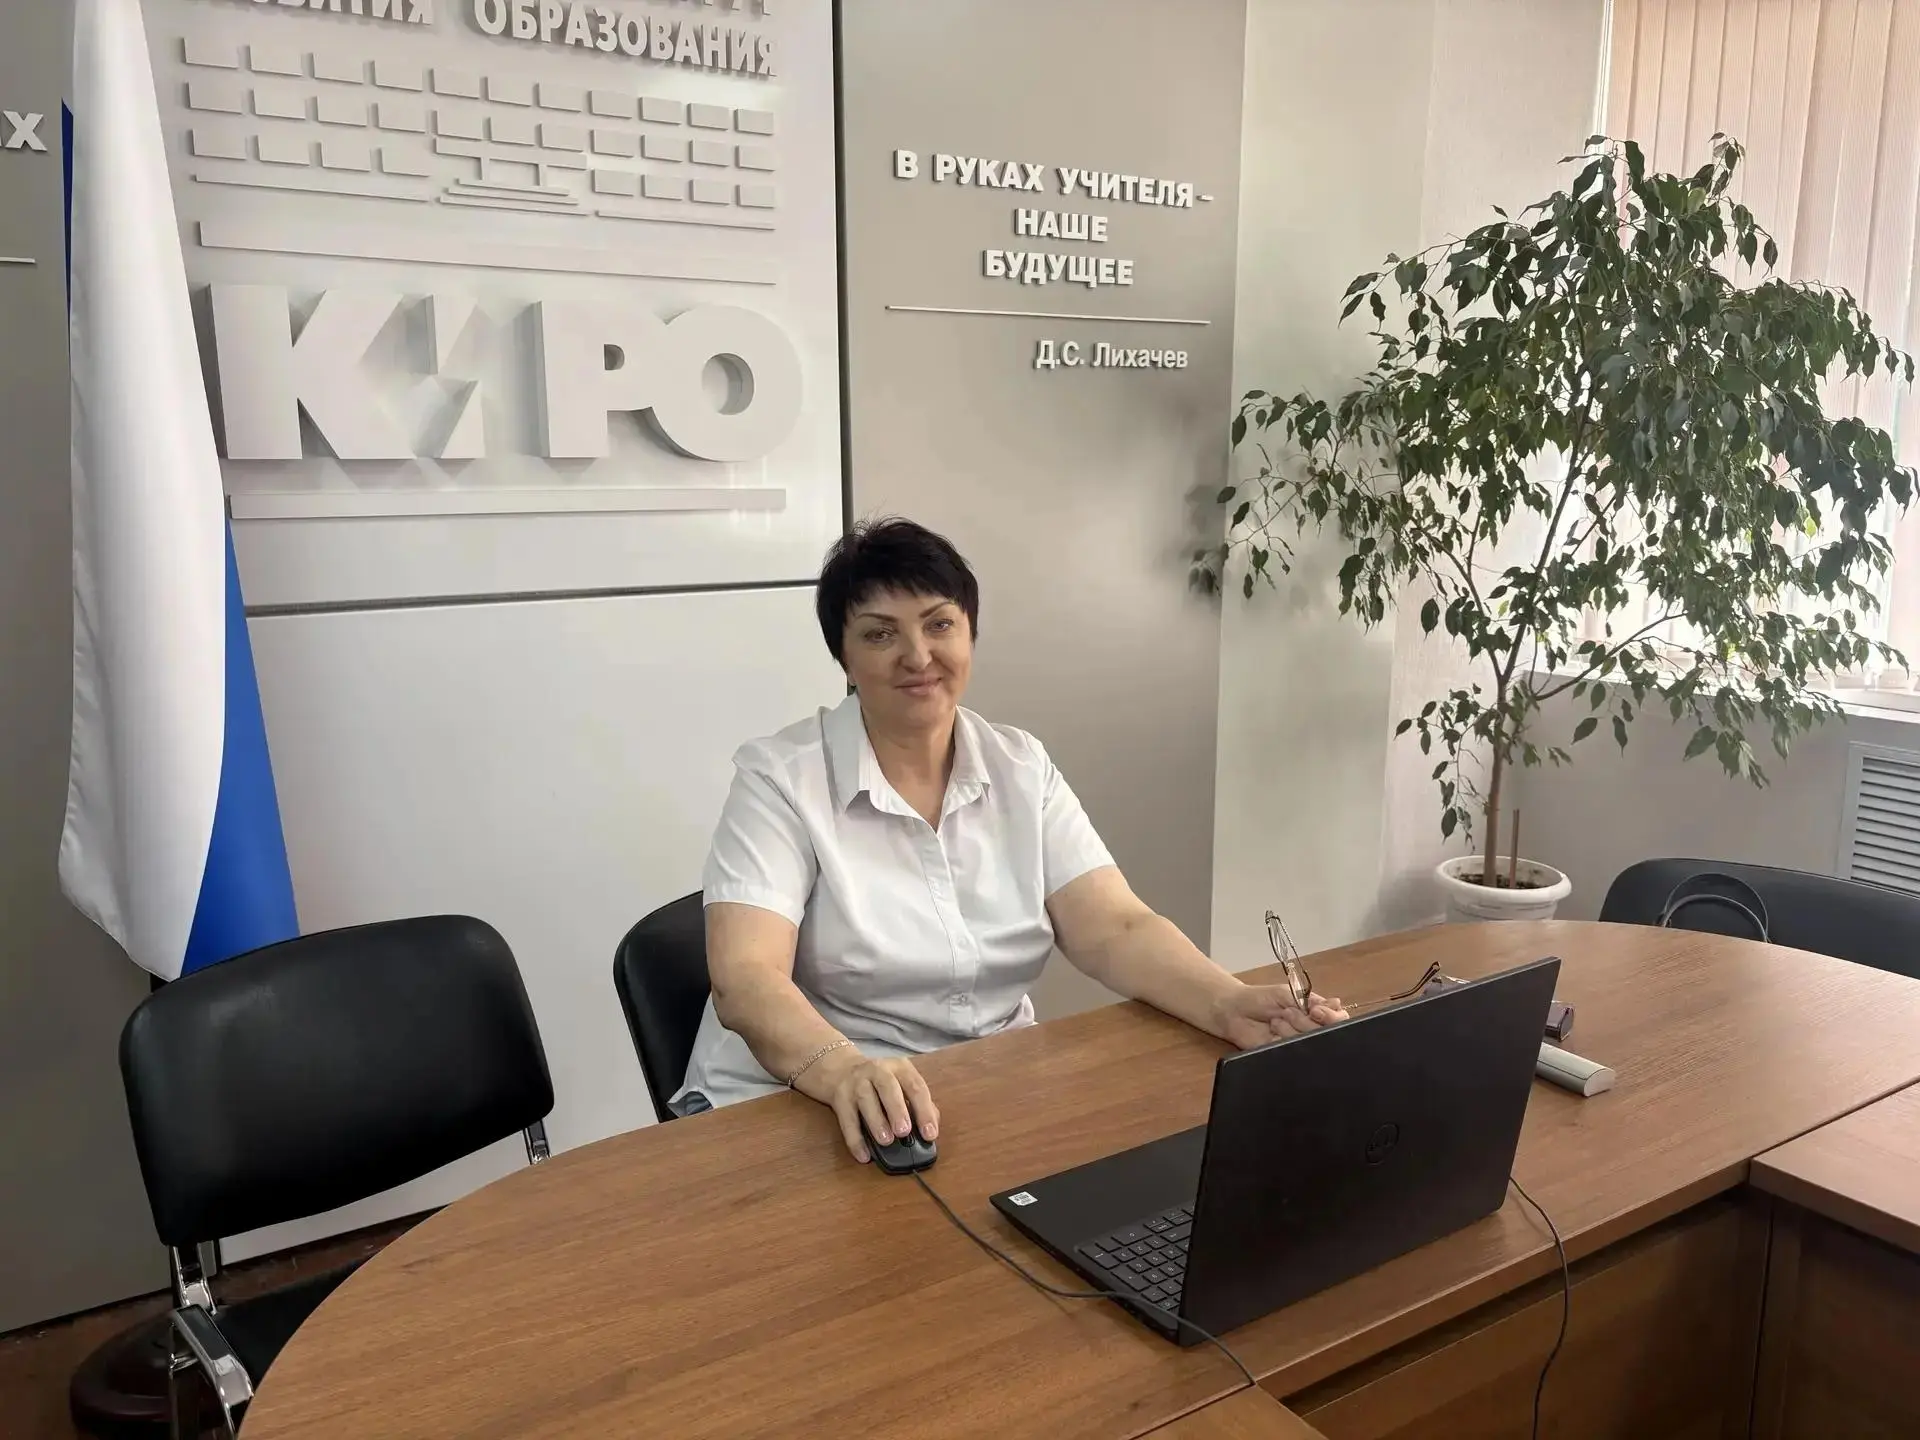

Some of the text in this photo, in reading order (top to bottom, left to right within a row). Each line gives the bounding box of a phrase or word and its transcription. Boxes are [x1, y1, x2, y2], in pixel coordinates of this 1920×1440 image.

[474, 0, 776, 76] ОБРАЗОВАНИЯ
[0, 110, 48, 152] Х
[894, 149, 919, 179] В
[933, 153, 1045, 192] РУКАХ
[1014, 208, 1109, 242] НАШЕ
[983, 249, 1134, 288] БУДУЩЕЕ
[210, 283, 802, 462] КИРО
[1035, 340, 1189, 369] Д.С. Лихачев
